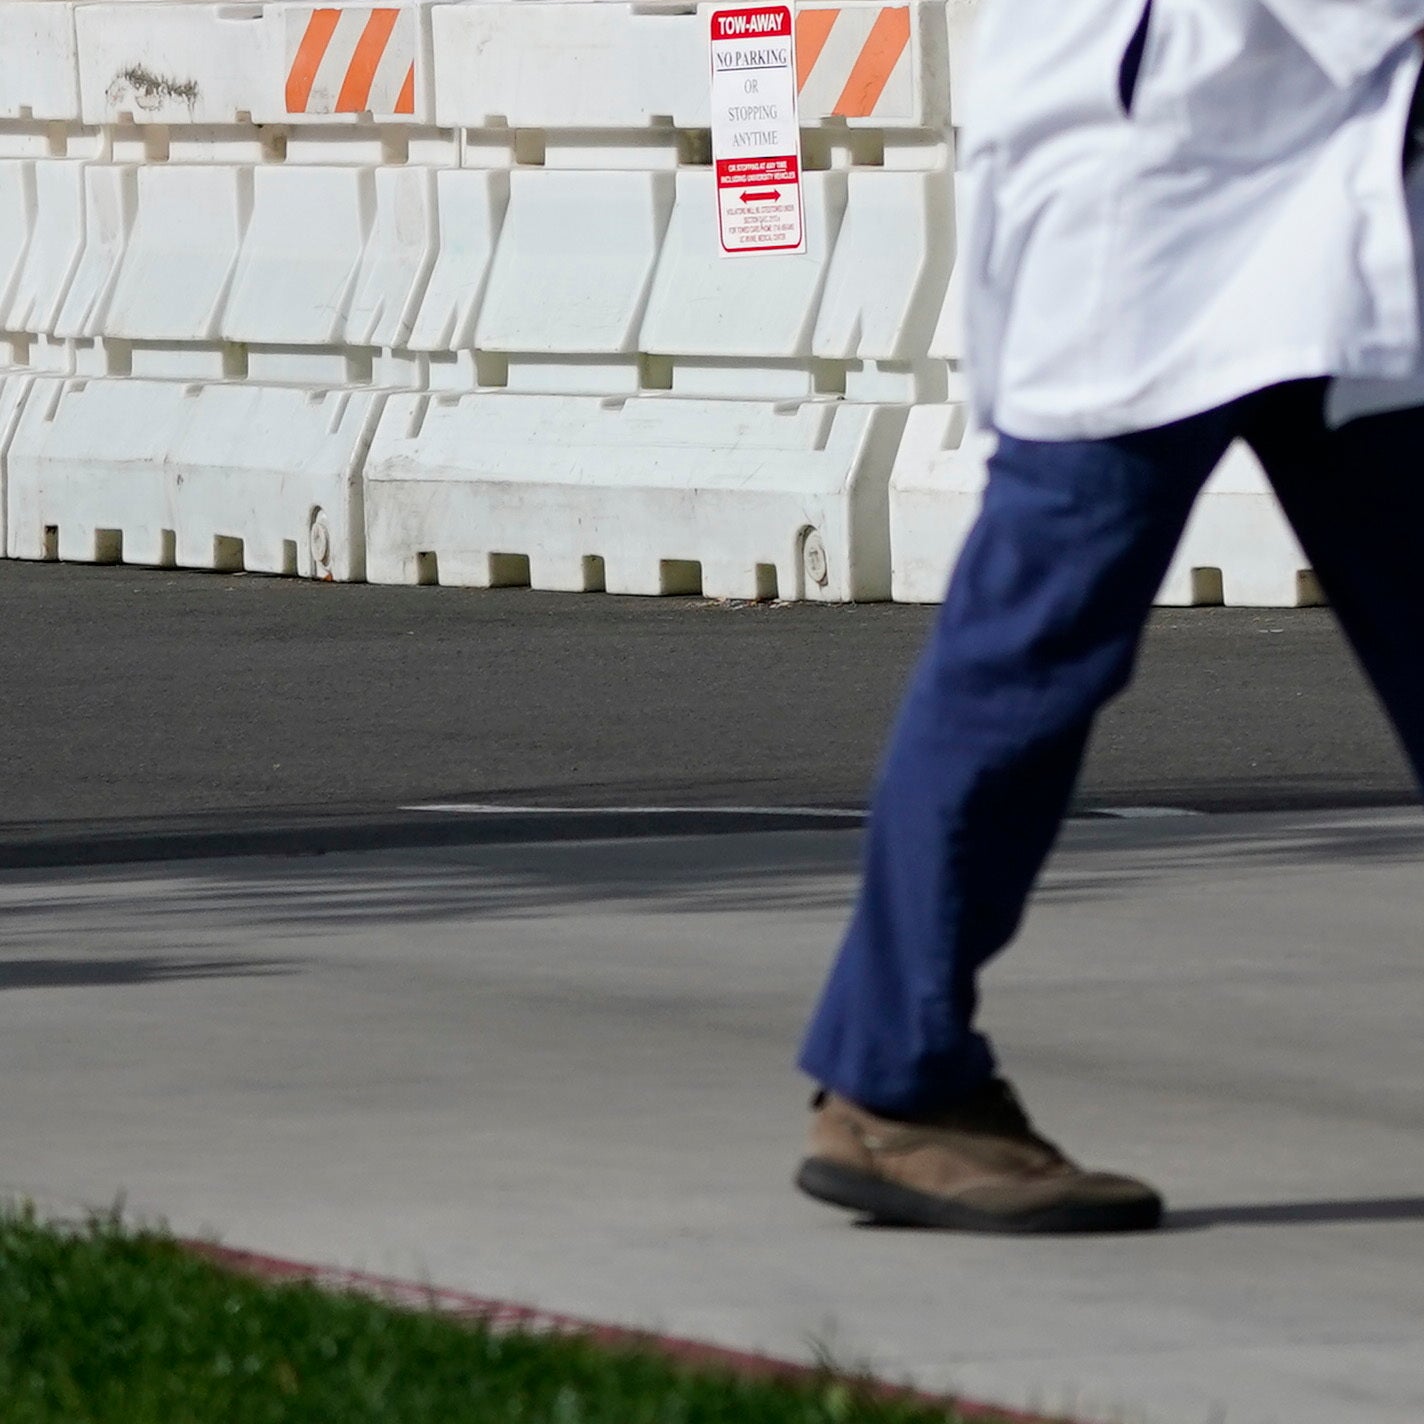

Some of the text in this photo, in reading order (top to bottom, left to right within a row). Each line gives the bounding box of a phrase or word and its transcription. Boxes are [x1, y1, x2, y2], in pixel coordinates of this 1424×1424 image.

[718, 12, 784, 36] TOW-AWAY
[716, 48, 787, 68] NO PARKING
[744, 79, 759, 94] OR
[728, 104, 777, 121] STOPPING
[732, 130, 778, 147] ANYTIME
